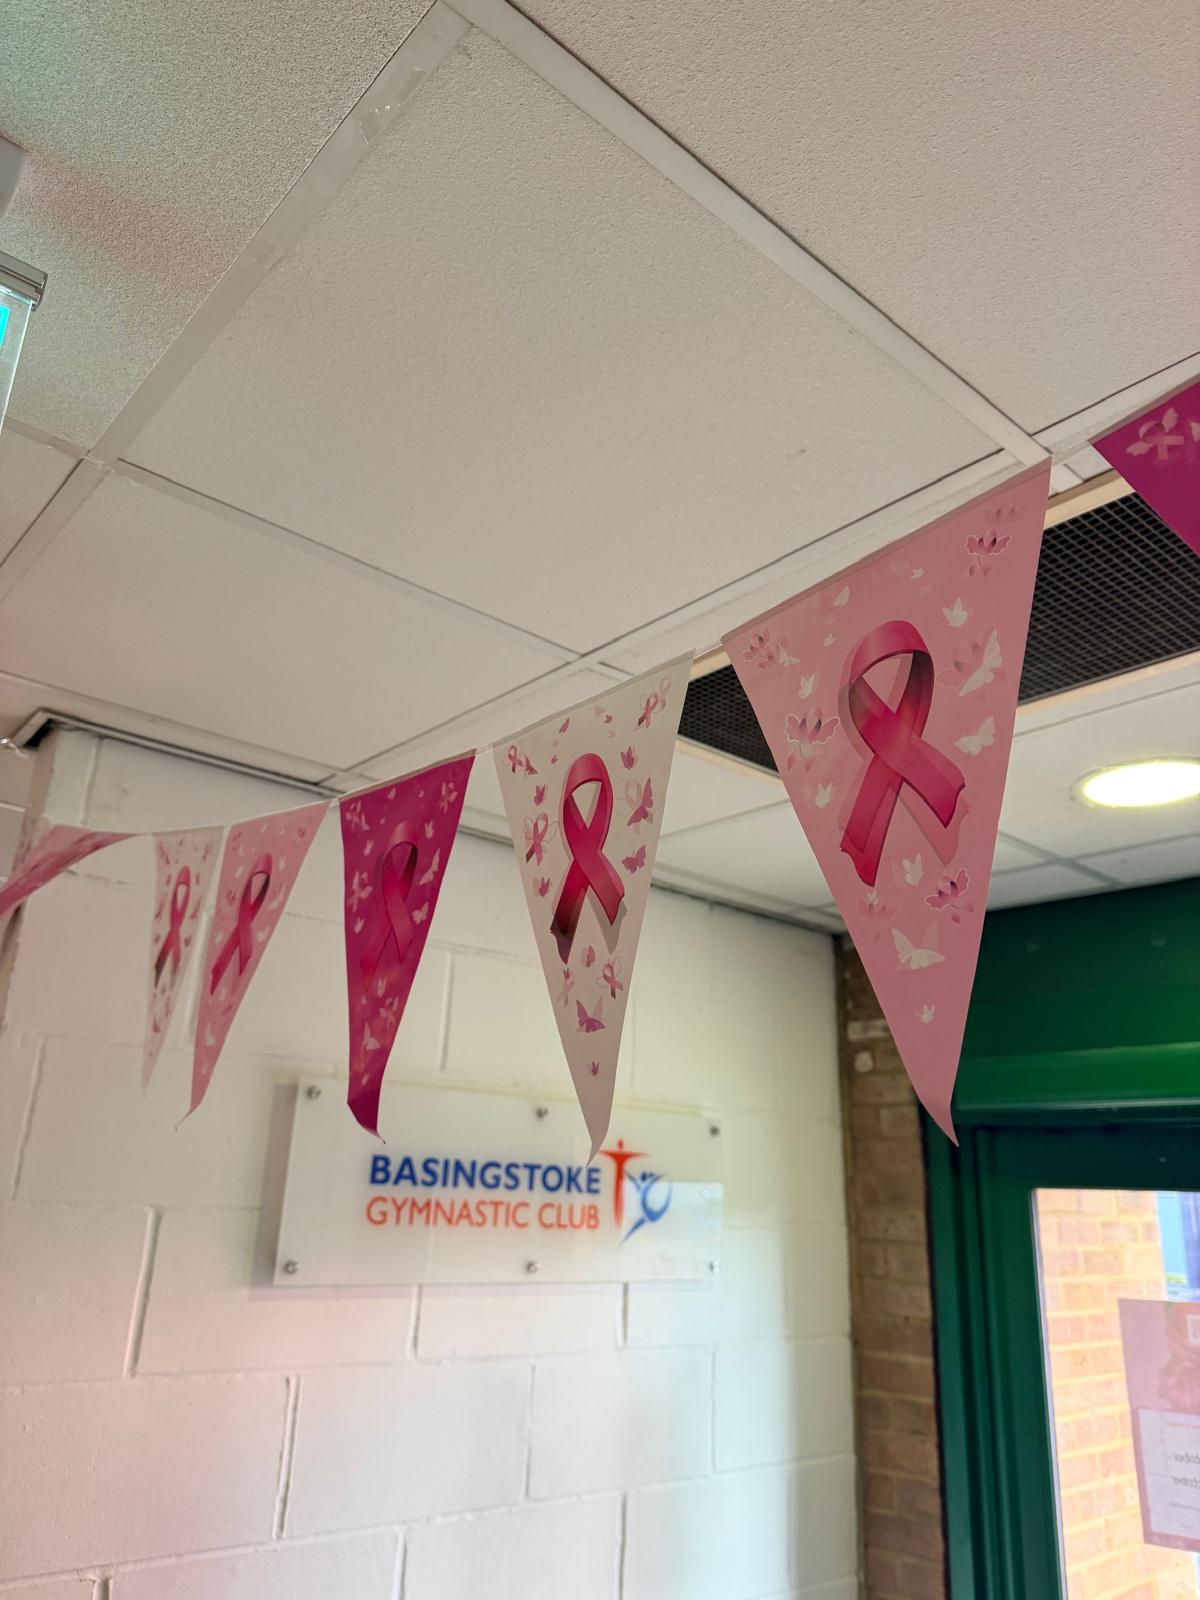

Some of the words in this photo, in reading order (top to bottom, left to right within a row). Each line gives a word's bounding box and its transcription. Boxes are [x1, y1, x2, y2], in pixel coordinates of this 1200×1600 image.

[369, 1154, 600, 1194] BASINGSTOKE
[366, 1195, 529, 1229] GYMNASTIC
[537, 1202, 599, 1230] CLUB
